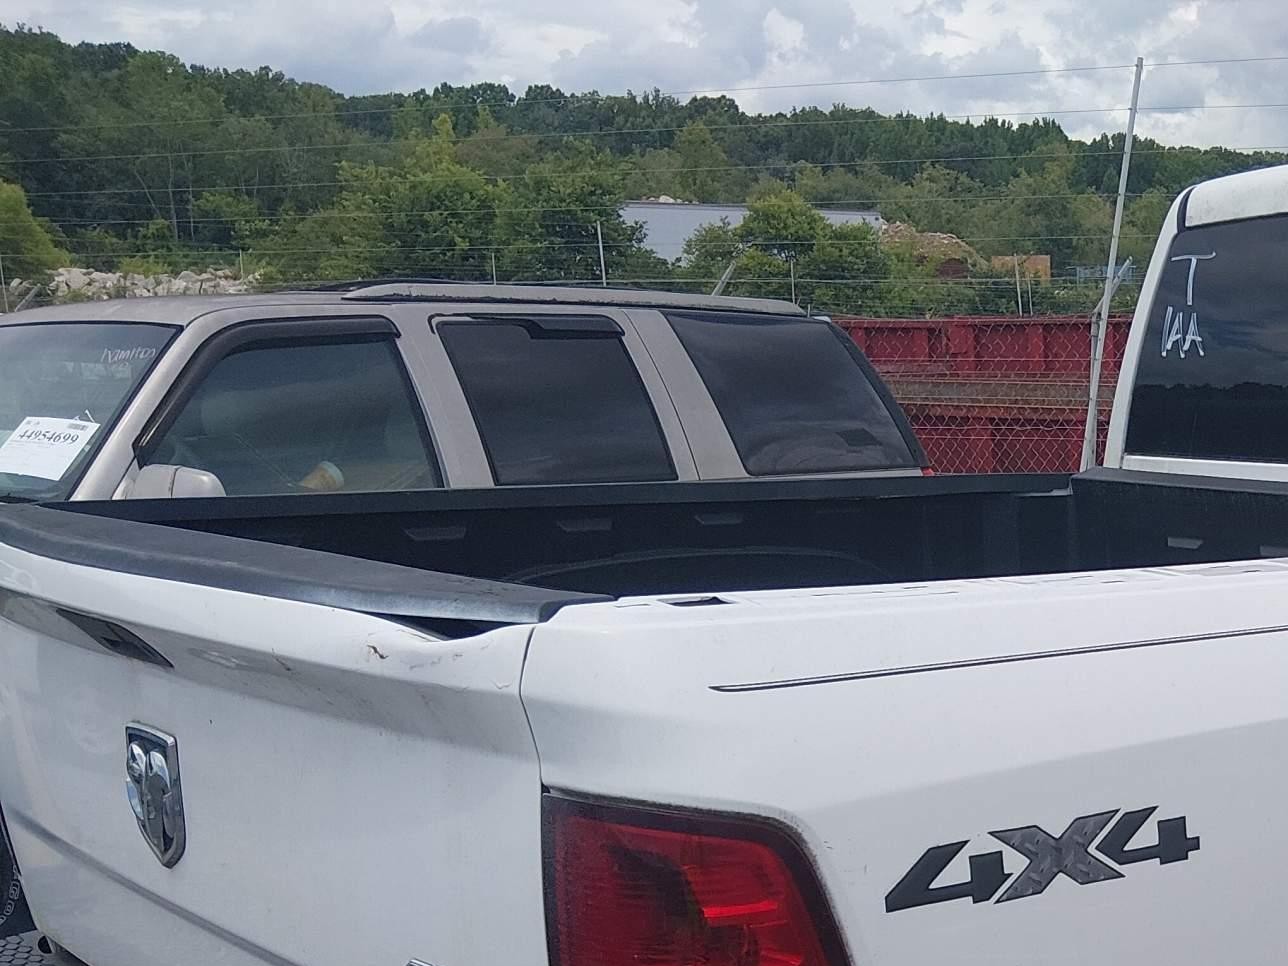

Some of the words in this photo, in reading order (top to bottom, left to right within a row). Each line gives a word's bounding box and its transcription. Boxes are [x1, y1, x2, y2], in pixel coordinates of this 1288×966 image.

[1171, 251, 1217, 306] T
[1161, 305, 1205, 359] IAA
[19, 429, 80, 445] 44954699
